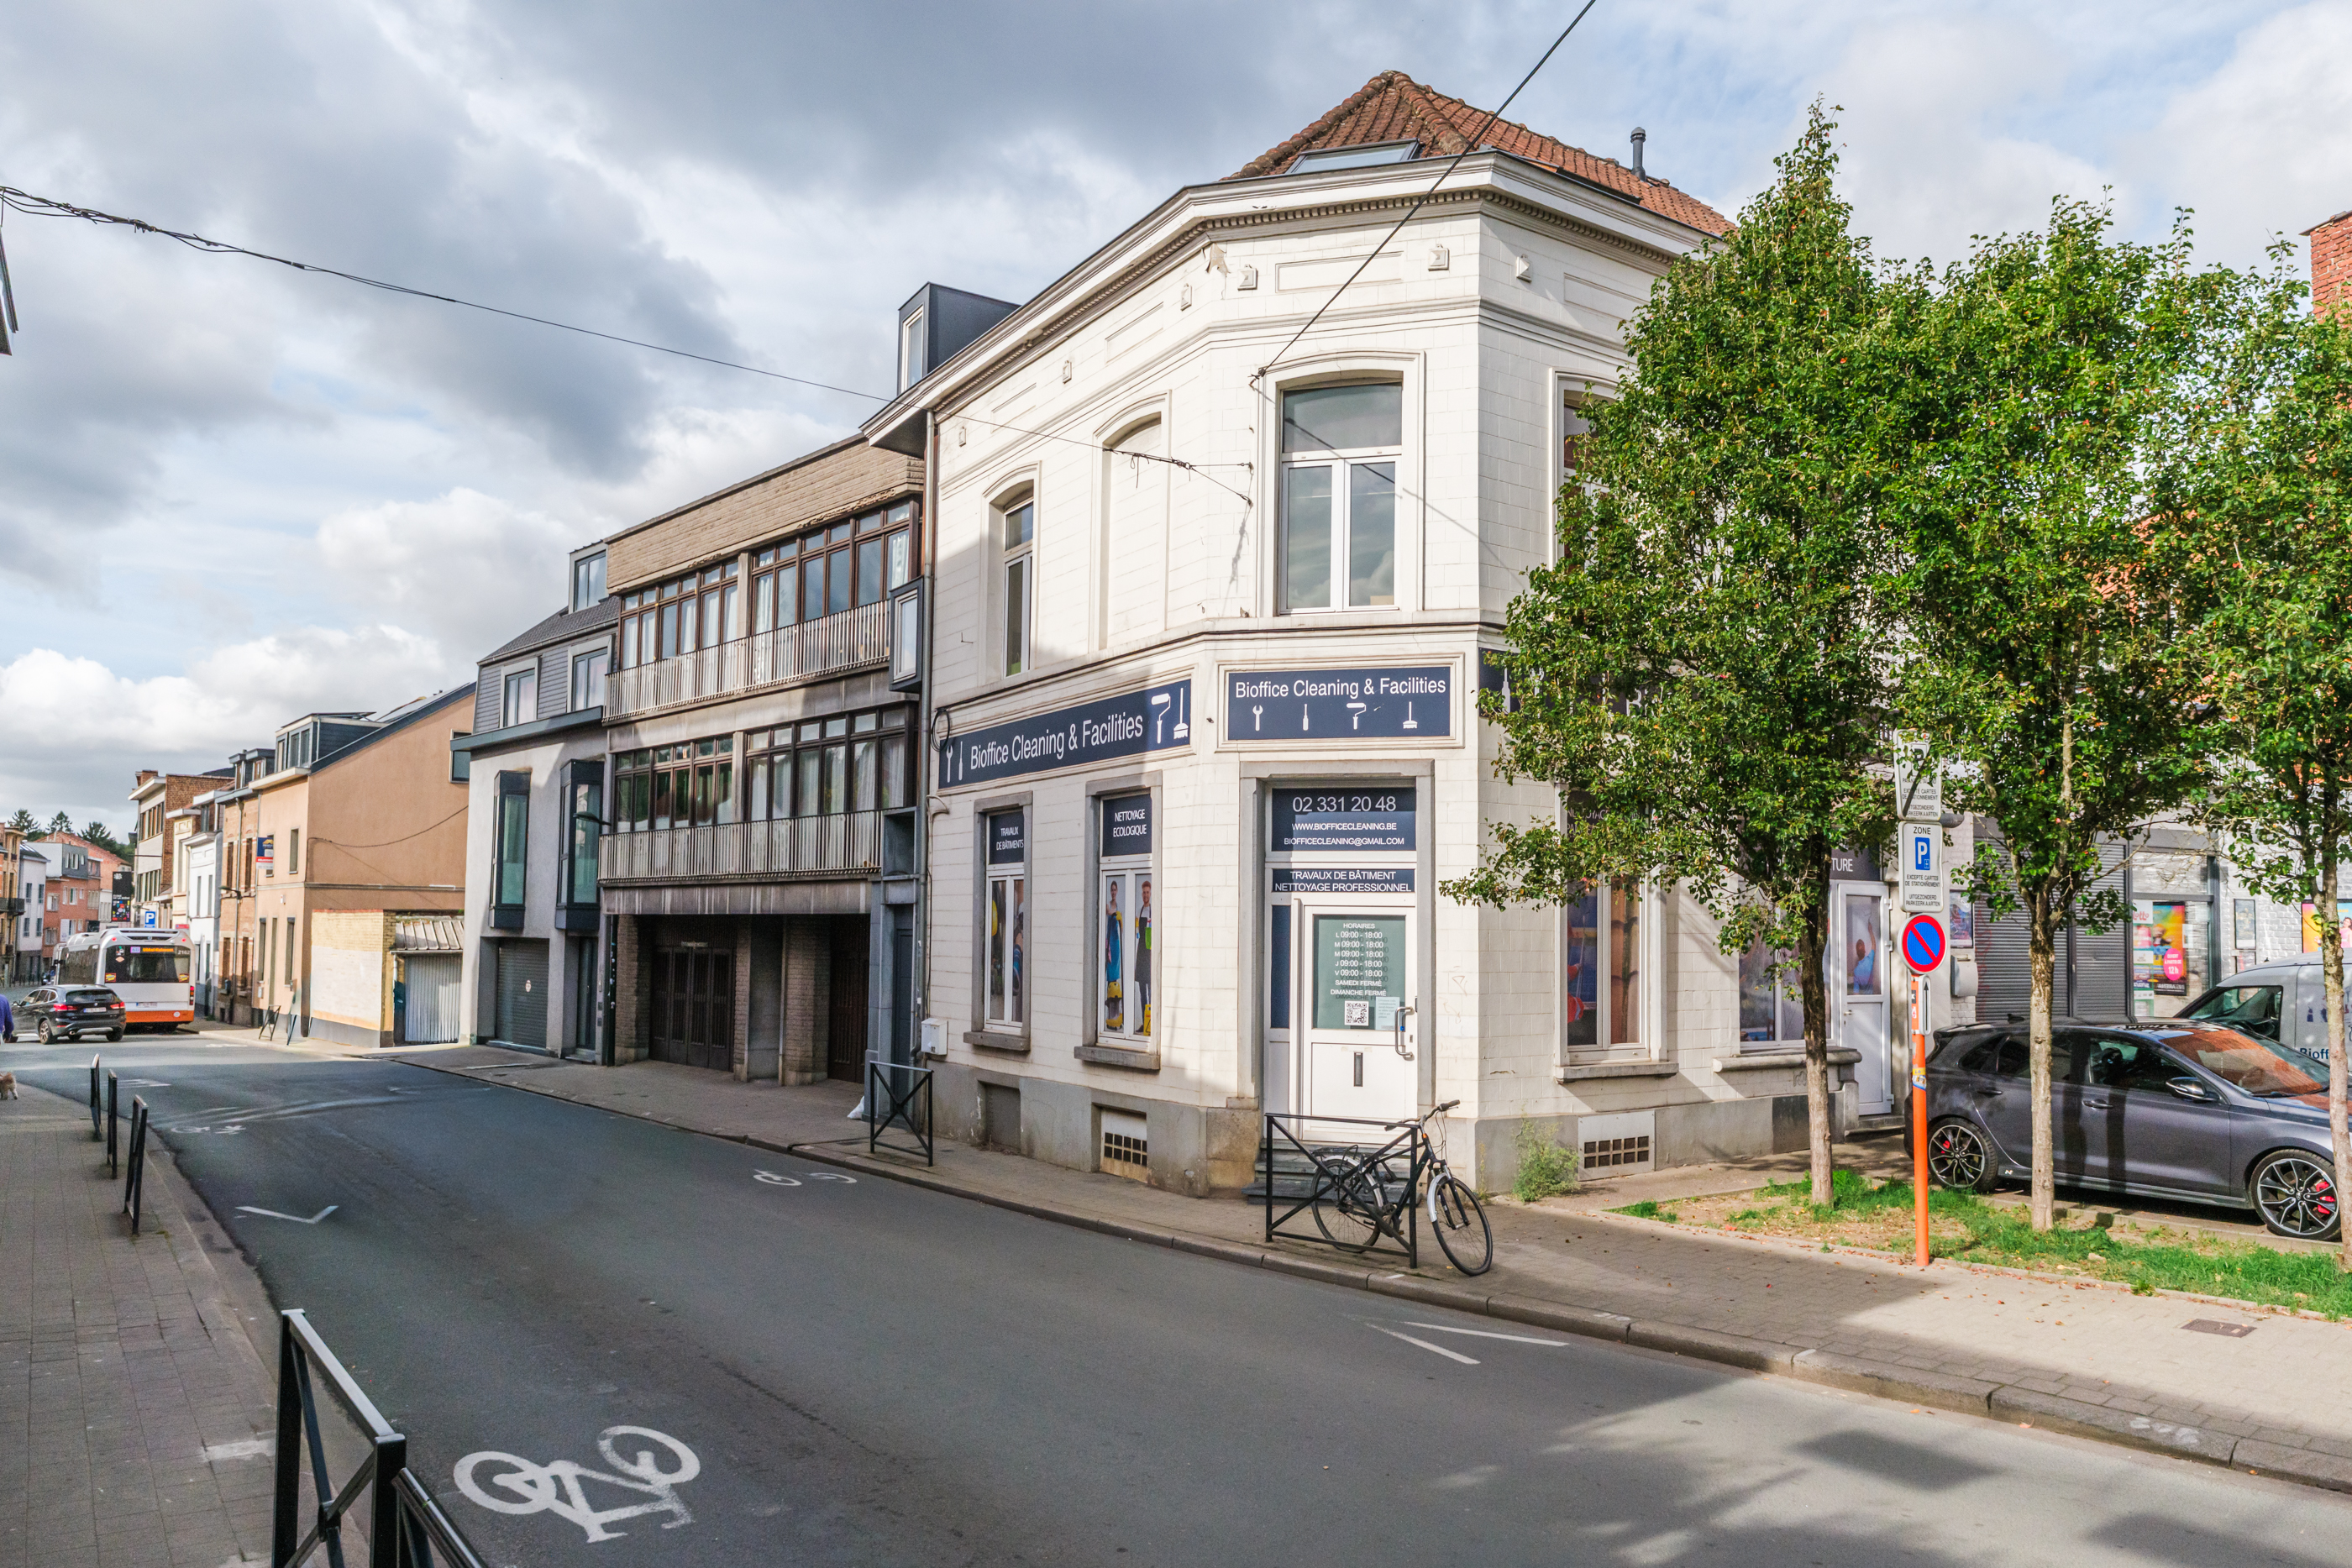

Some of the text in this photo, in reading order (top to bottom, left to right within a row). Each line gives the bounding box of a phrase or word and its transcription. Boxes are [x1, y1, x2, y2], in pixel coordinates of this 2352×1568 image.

[1236, 677, 1446, 700] Bioffice Cleaning & Facilities
[971, 712, 1143, 769] Bioffice Cleaning & Facilities
[1292, 796, 1396, 812] 02 331 20 48
[1115, 809, 1145, 822] NETTOYAGE
[1000, 826, 1019, 836] TRAVAUX
[1113, 824, 1147, 837] ECOLOGIQUE
[1914, 826, 1931, 835] ZONE
[996, 839, 1024, 851] DE BÂTIMENTS
[1284, 837, 1404, 846] BIOFFICECLEANING@GMAIL.COM
[1918, 842, 1928, 865] P
[1831, 857, 1854, 872] TURE
[1290, 869, 1396, 880] TRAVAUX DE BÂTIMENT
[1275, 883, 1411, 892] NETTOYAGE PROFESSIONNEL
[145, 912, 155, 923] P
[2168, 966, 2174, 974] 12
[2300, 1048, 2329, 1060] Bioff
